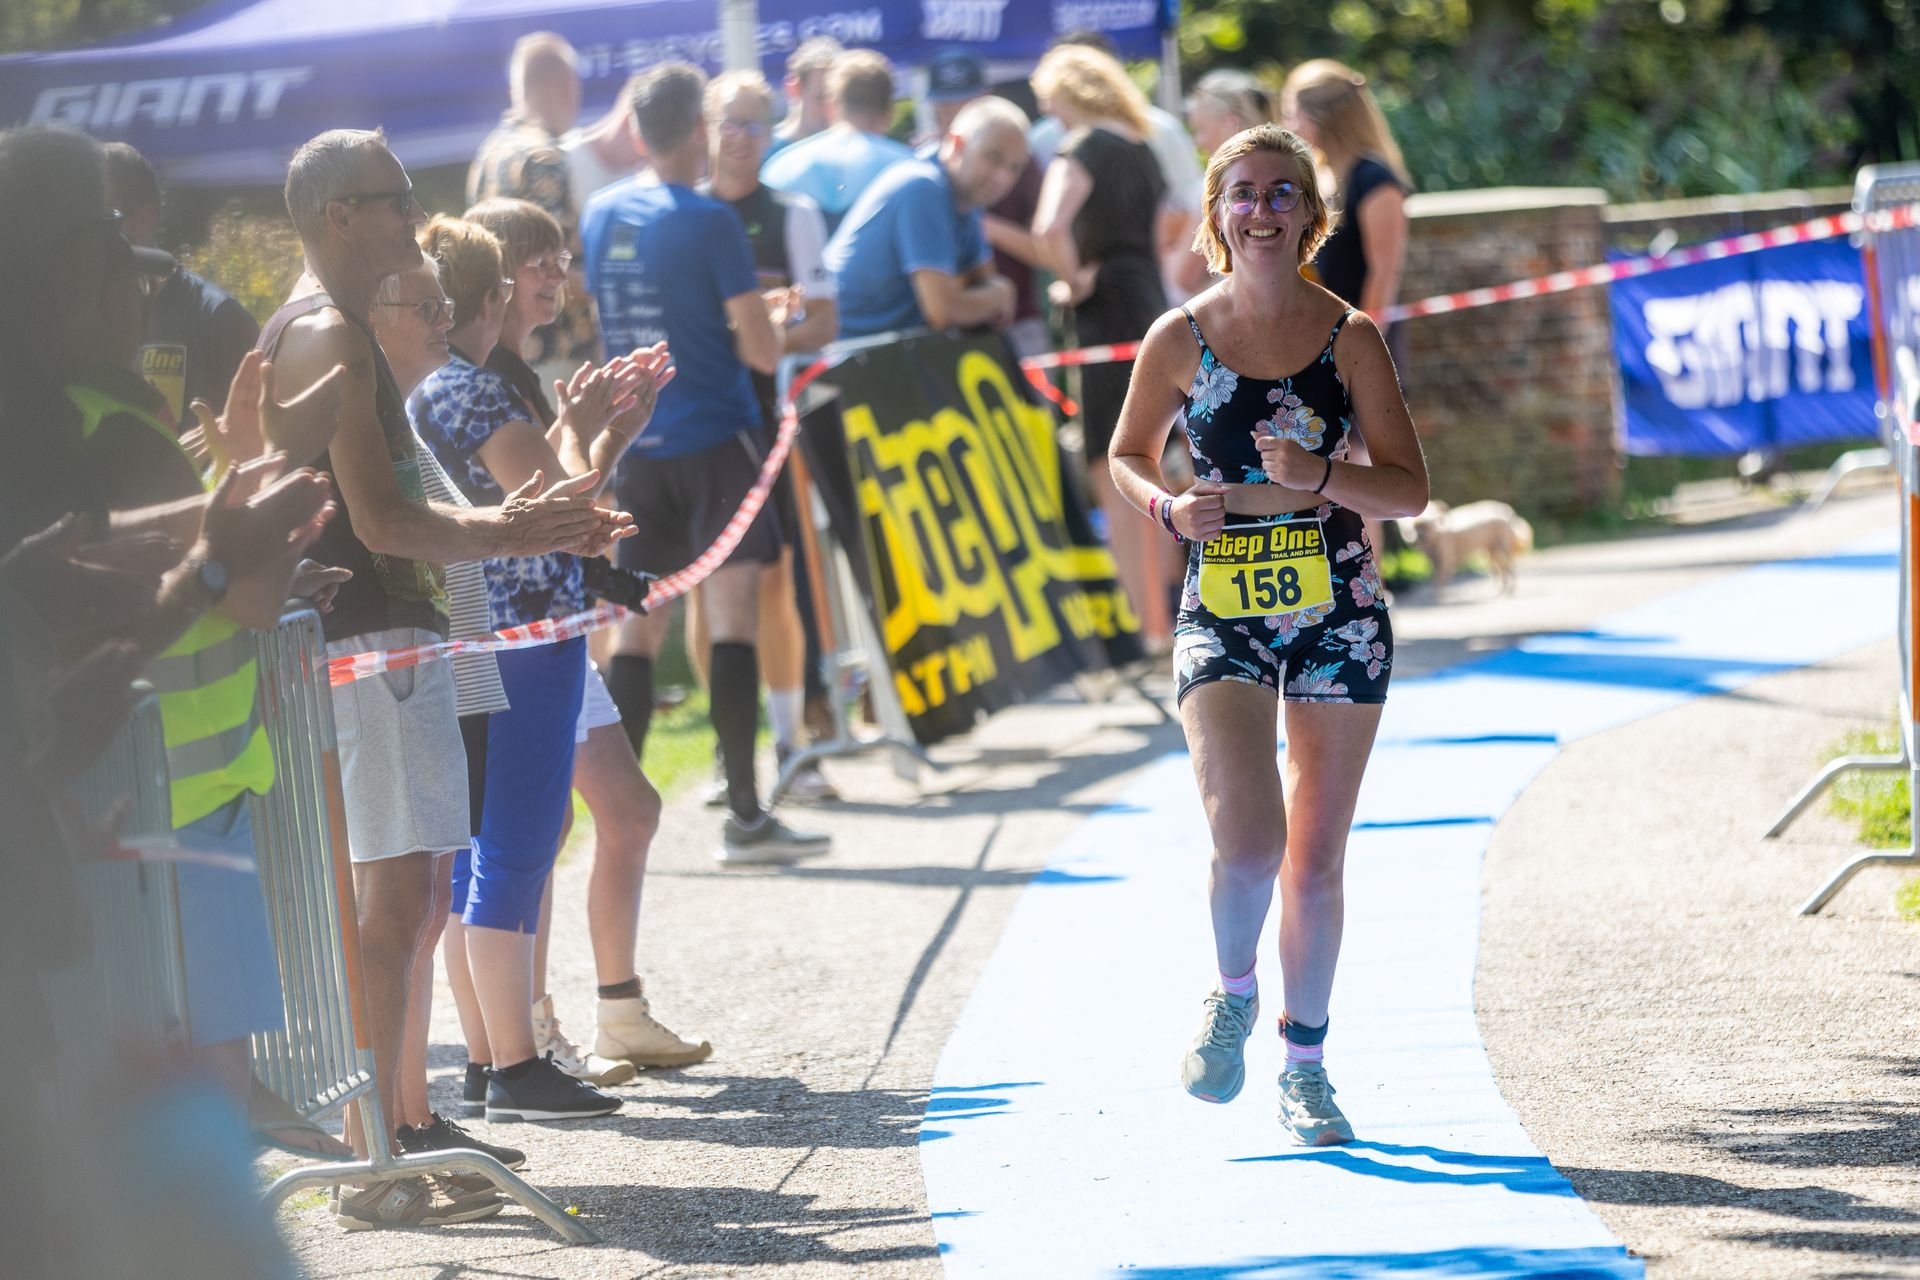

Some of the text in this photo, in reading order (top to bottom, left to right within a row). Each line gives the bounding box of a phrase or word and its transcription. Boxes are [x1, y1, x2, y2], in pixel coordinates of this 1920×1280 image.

[28, 65, 313, 129] GIANT
[1203, 526, 1320, 562] Step One
[1270, 552, 1289, 560] TRAIL
[1289, 550, 1304, 558] AND
[1230, 565, 1302, 610] 158
